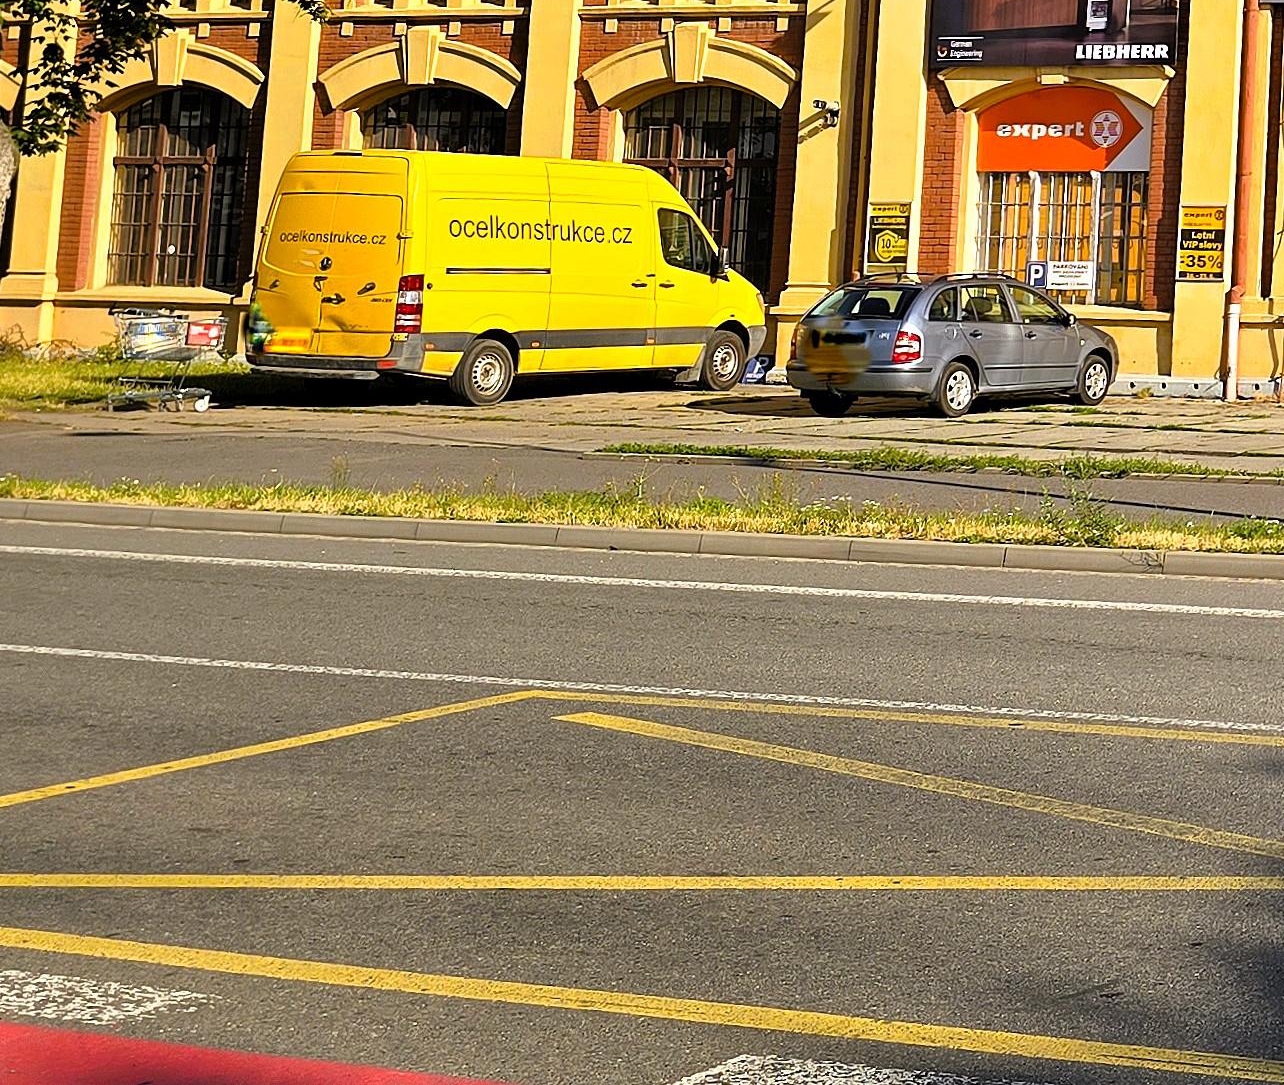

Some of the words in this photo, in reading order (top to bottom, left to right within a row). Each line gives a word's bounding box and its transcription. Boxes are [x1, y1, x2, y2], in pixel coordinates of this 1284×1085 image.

[1075, 44, 1169, 60] LIEBHERR
[995, 121, 1085, 140] expert
[279, 230, 387, 246] ocelkonstrukce.cz
[448, 214, 633, 245] ocelkonstrukce.cz
[881, 238, 892, 249] 10
[1029, 264, 1044, 286] P
